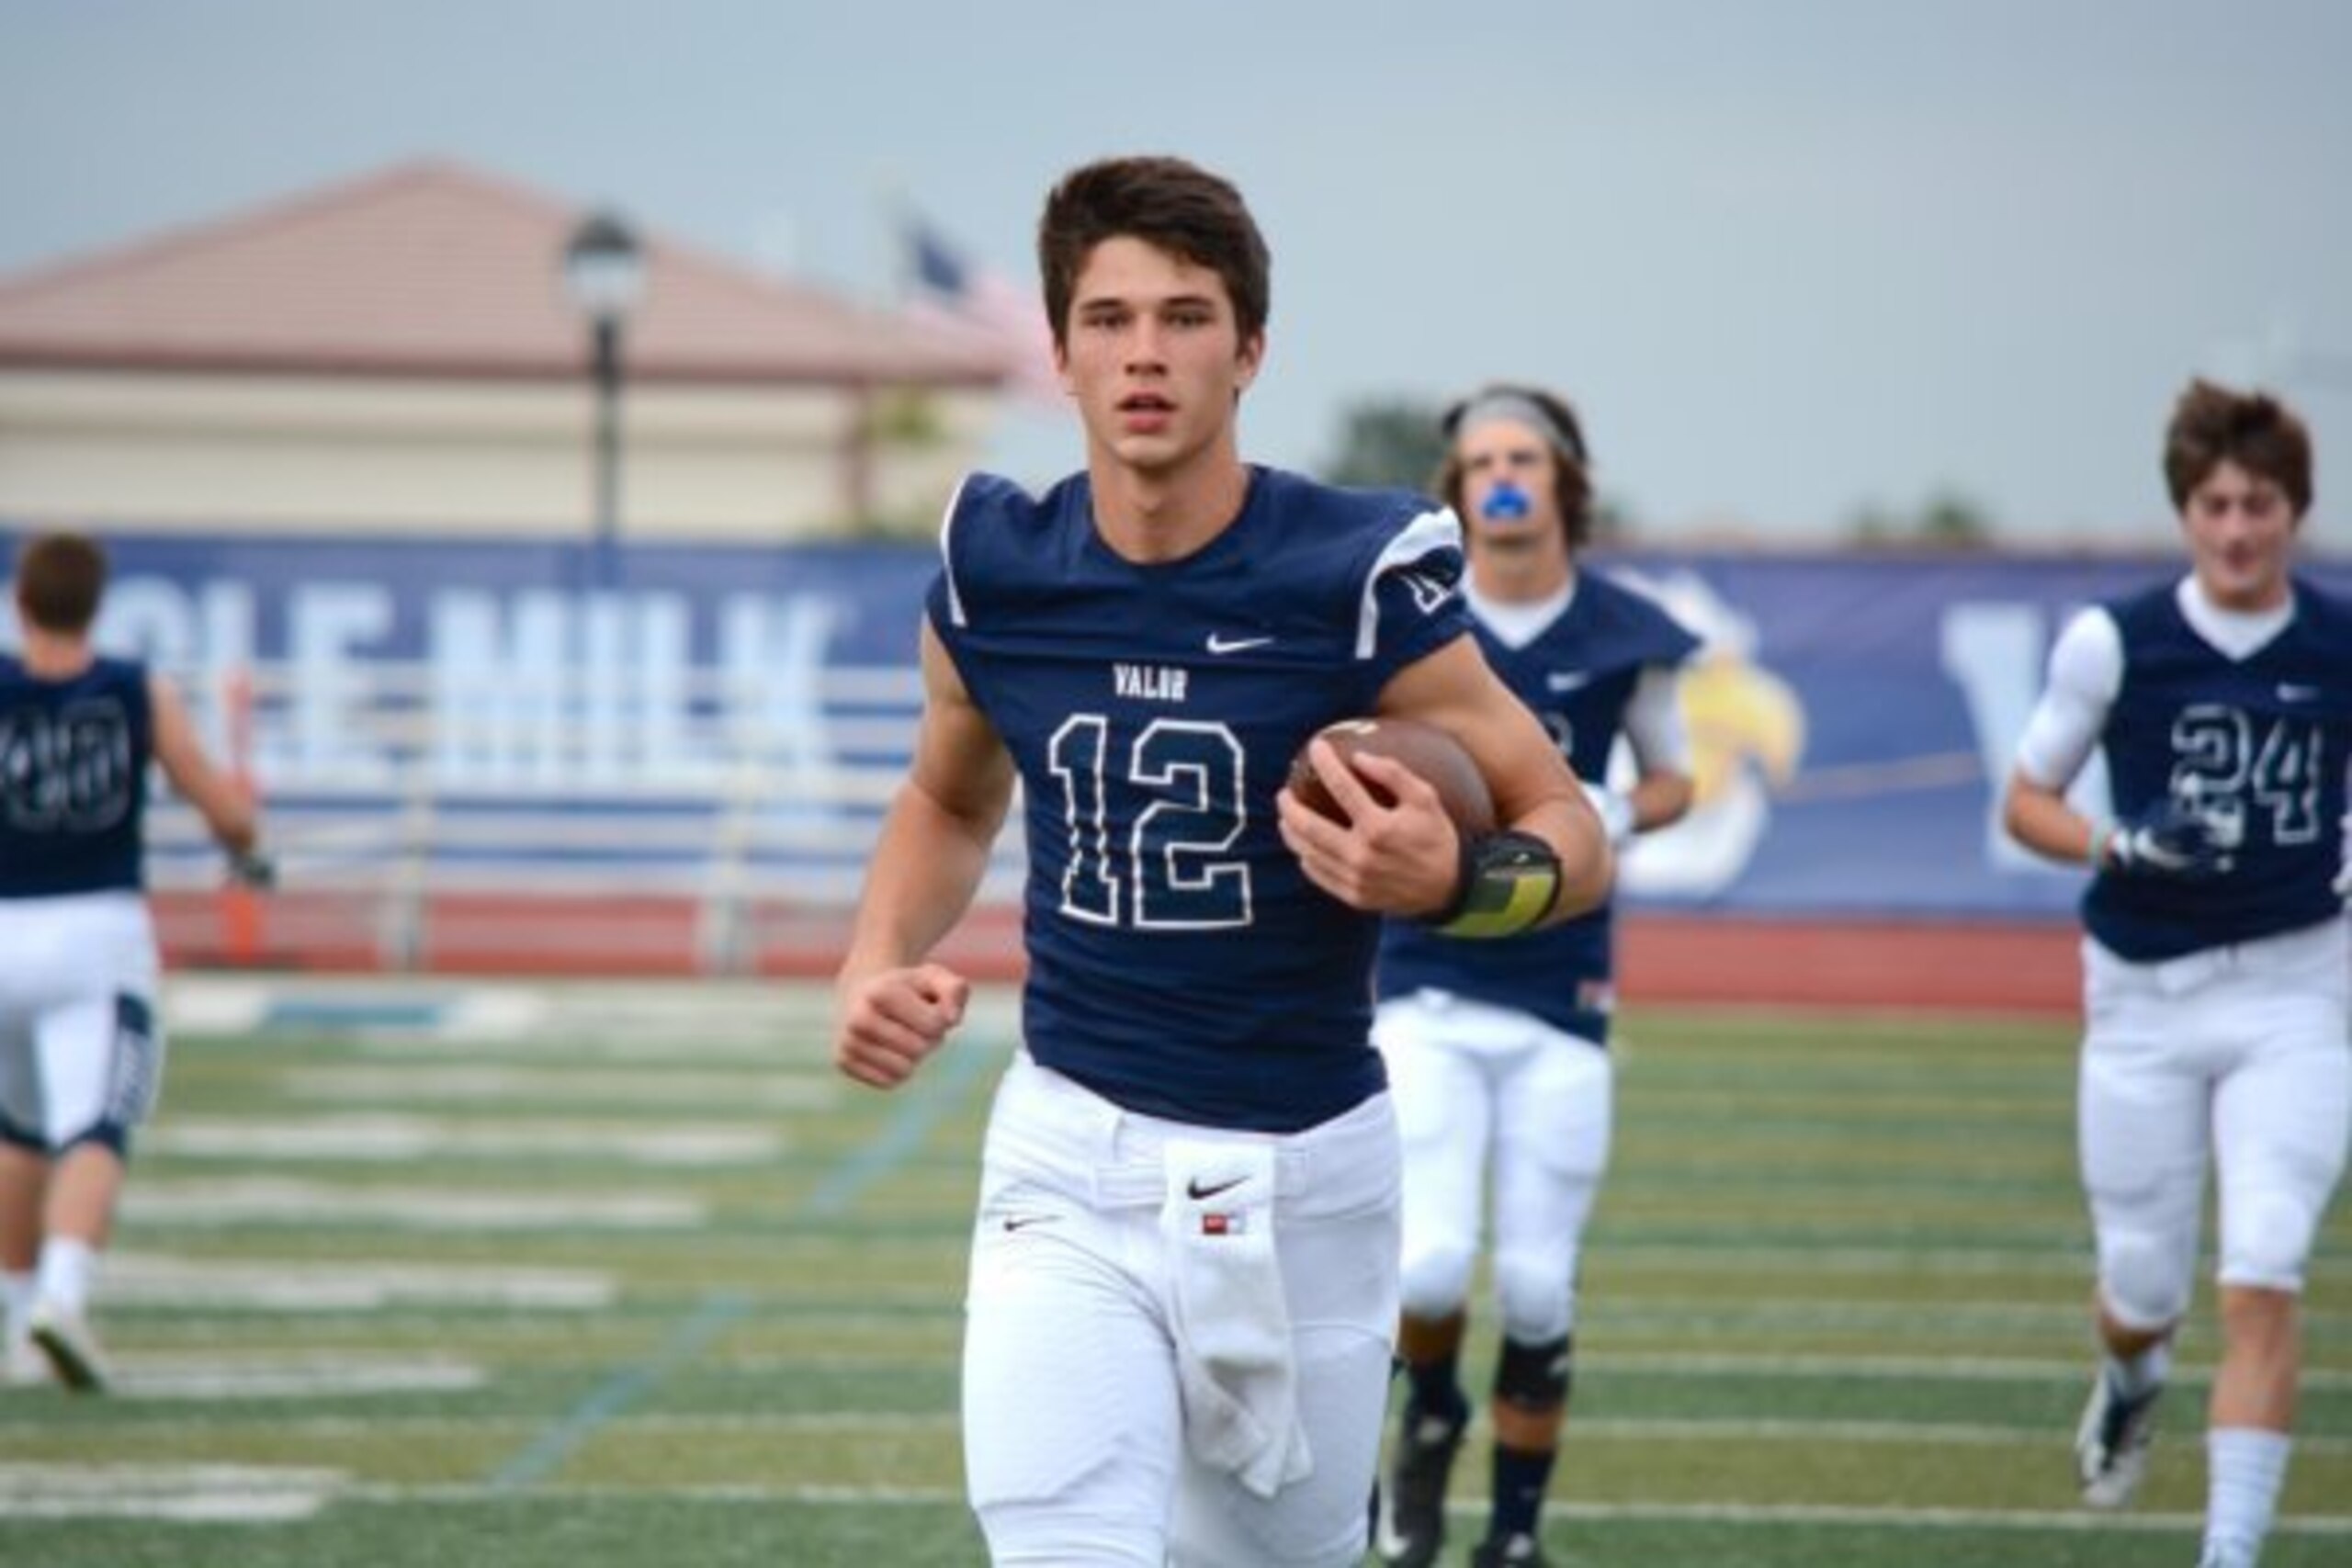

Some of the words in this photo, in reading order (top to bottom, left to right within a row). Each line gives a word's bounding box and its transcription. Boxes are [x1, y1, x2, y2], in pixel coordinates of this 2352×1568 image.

[432, 588, 854, 801] MILK
[1113, 662, 1188, 702] VALOR
[1047, 713, 1253, 929] 12
[2169, 704, 2322, 845] 24
